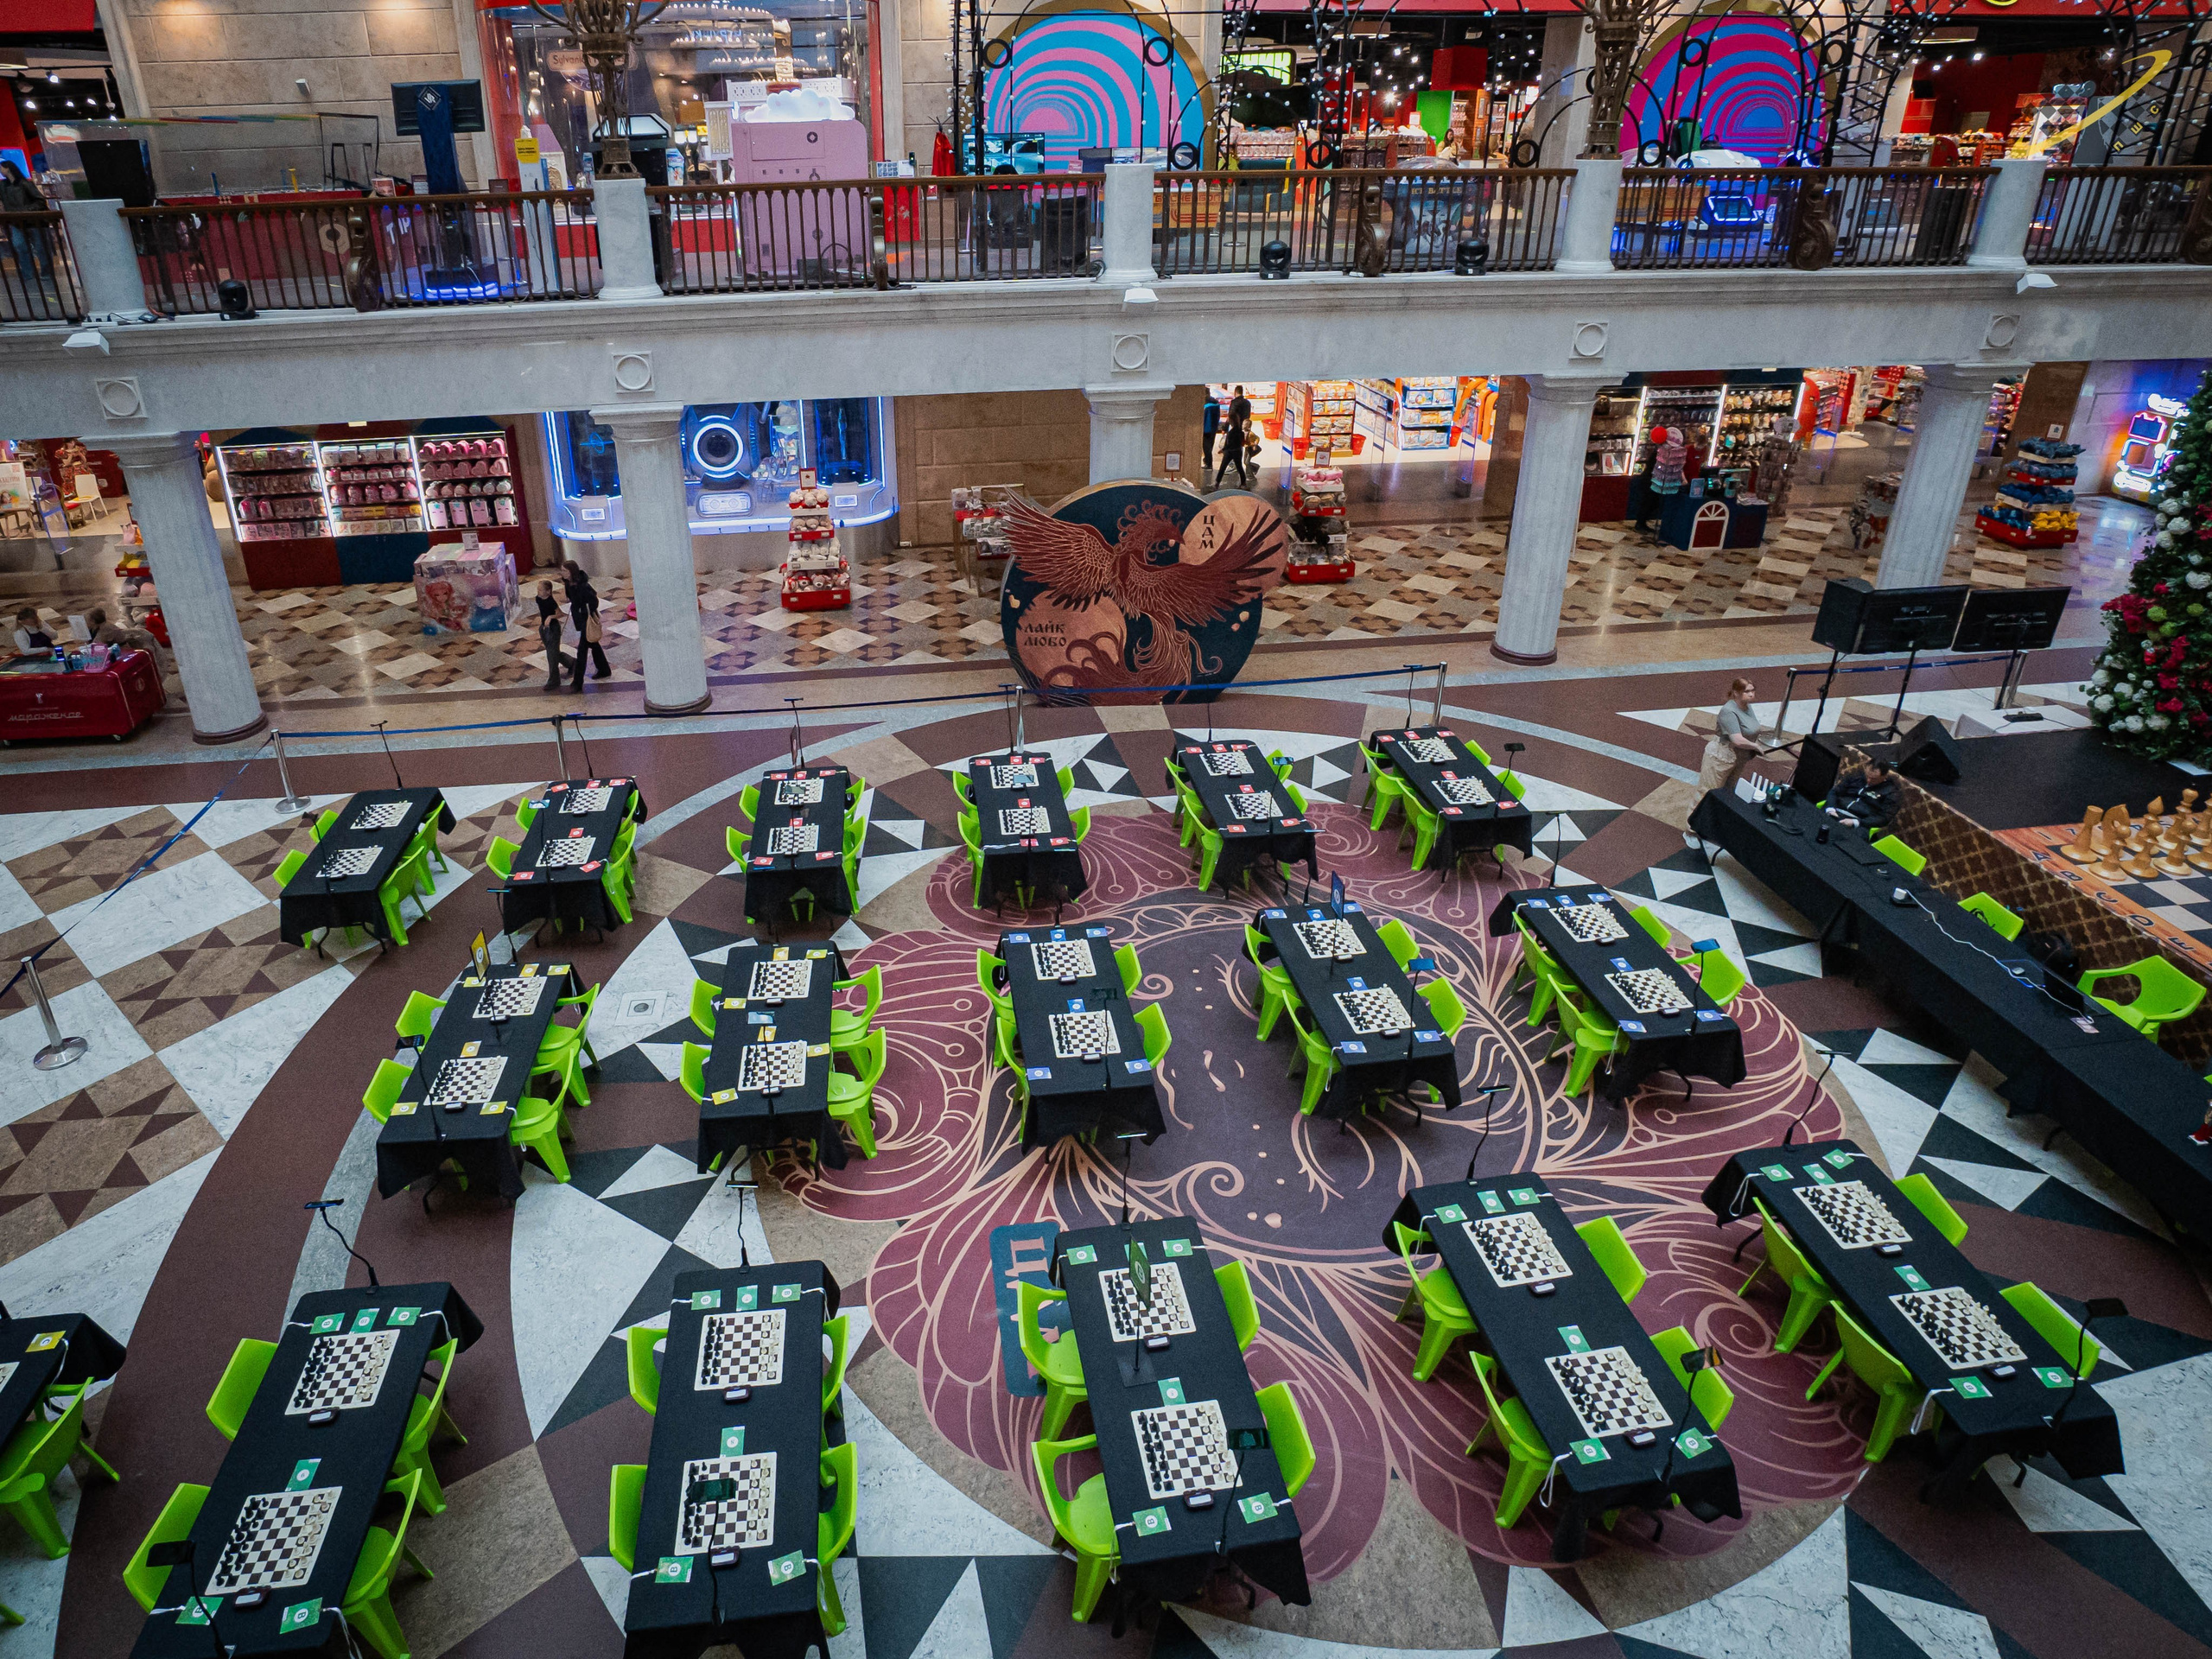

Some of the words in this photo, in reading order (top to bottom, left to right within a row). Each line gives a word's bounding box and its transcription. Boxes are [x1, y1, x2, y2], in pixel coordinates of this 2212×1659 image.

[1024, 620, 1065, 633] ЛАЙК
[1024, 636, 1067, 647] ЛЮБО
[2032, 851, 2052, 861] A
[2060, 870, 2083, 881] B
[2095, 892, 2118, 903] C
[2128, 914, 2154, 926] D
[2167, 937, 2195, 950] E
